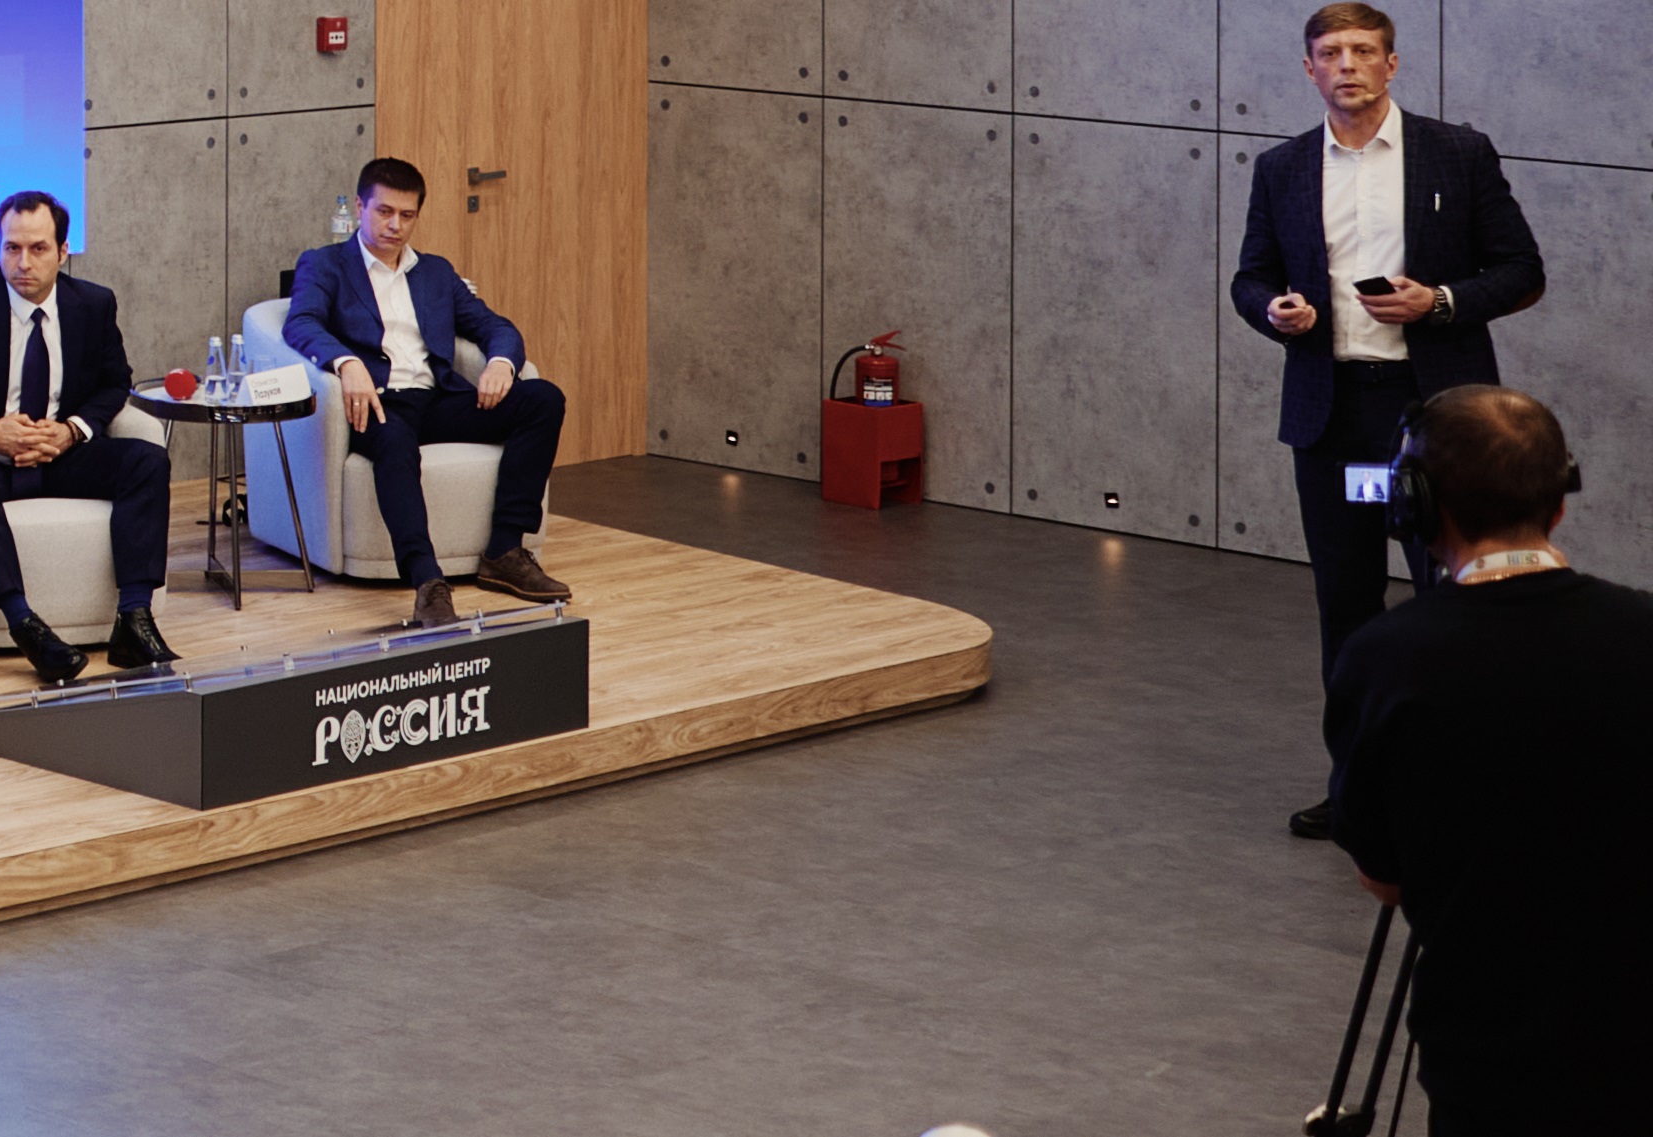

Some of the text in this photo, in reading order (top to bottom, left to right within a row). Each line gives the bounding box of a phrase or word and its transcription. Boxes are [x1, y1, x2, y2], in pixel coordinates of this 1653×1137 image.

[315, 657, 491, 707] НАЦИОНАЛЬНЫЙ ЦЕНТР
[312, 686, 491, 766] РОССИЯ
